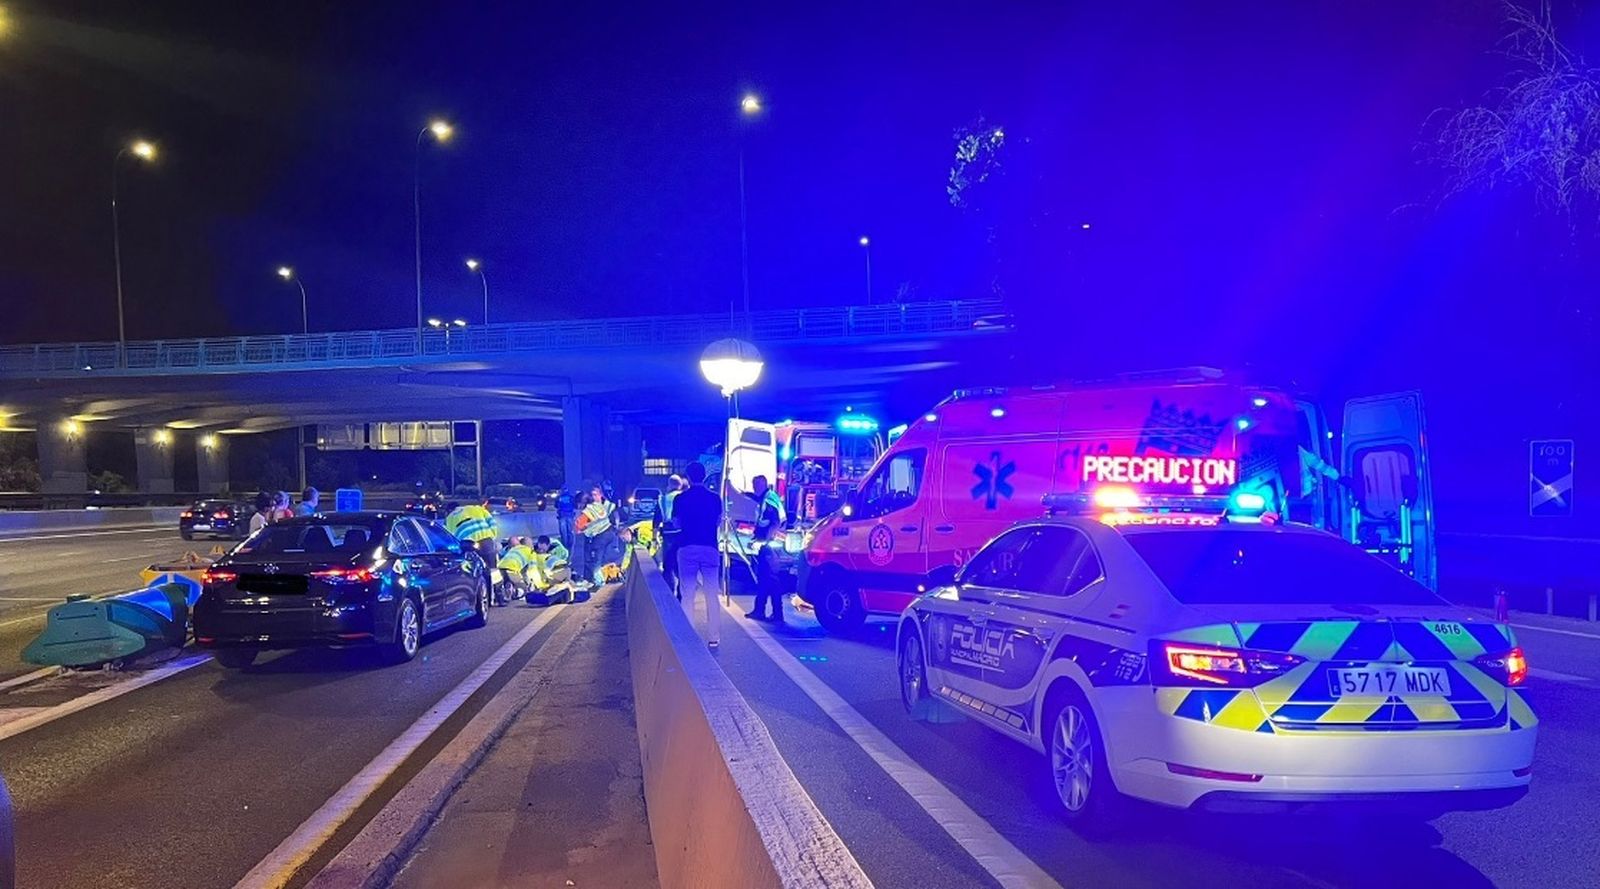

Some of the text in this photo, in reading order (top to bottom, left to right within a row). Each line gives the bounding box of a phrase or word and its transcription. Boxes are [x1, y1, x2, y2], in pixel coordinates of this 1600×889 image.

[1083, 455, 1236, 486] PRECAUCION
[1434, 623, 1461, 635] 4616
[1343, 671, 1398, 693] 5717
[1404, 671, 1444, 692] MDK
